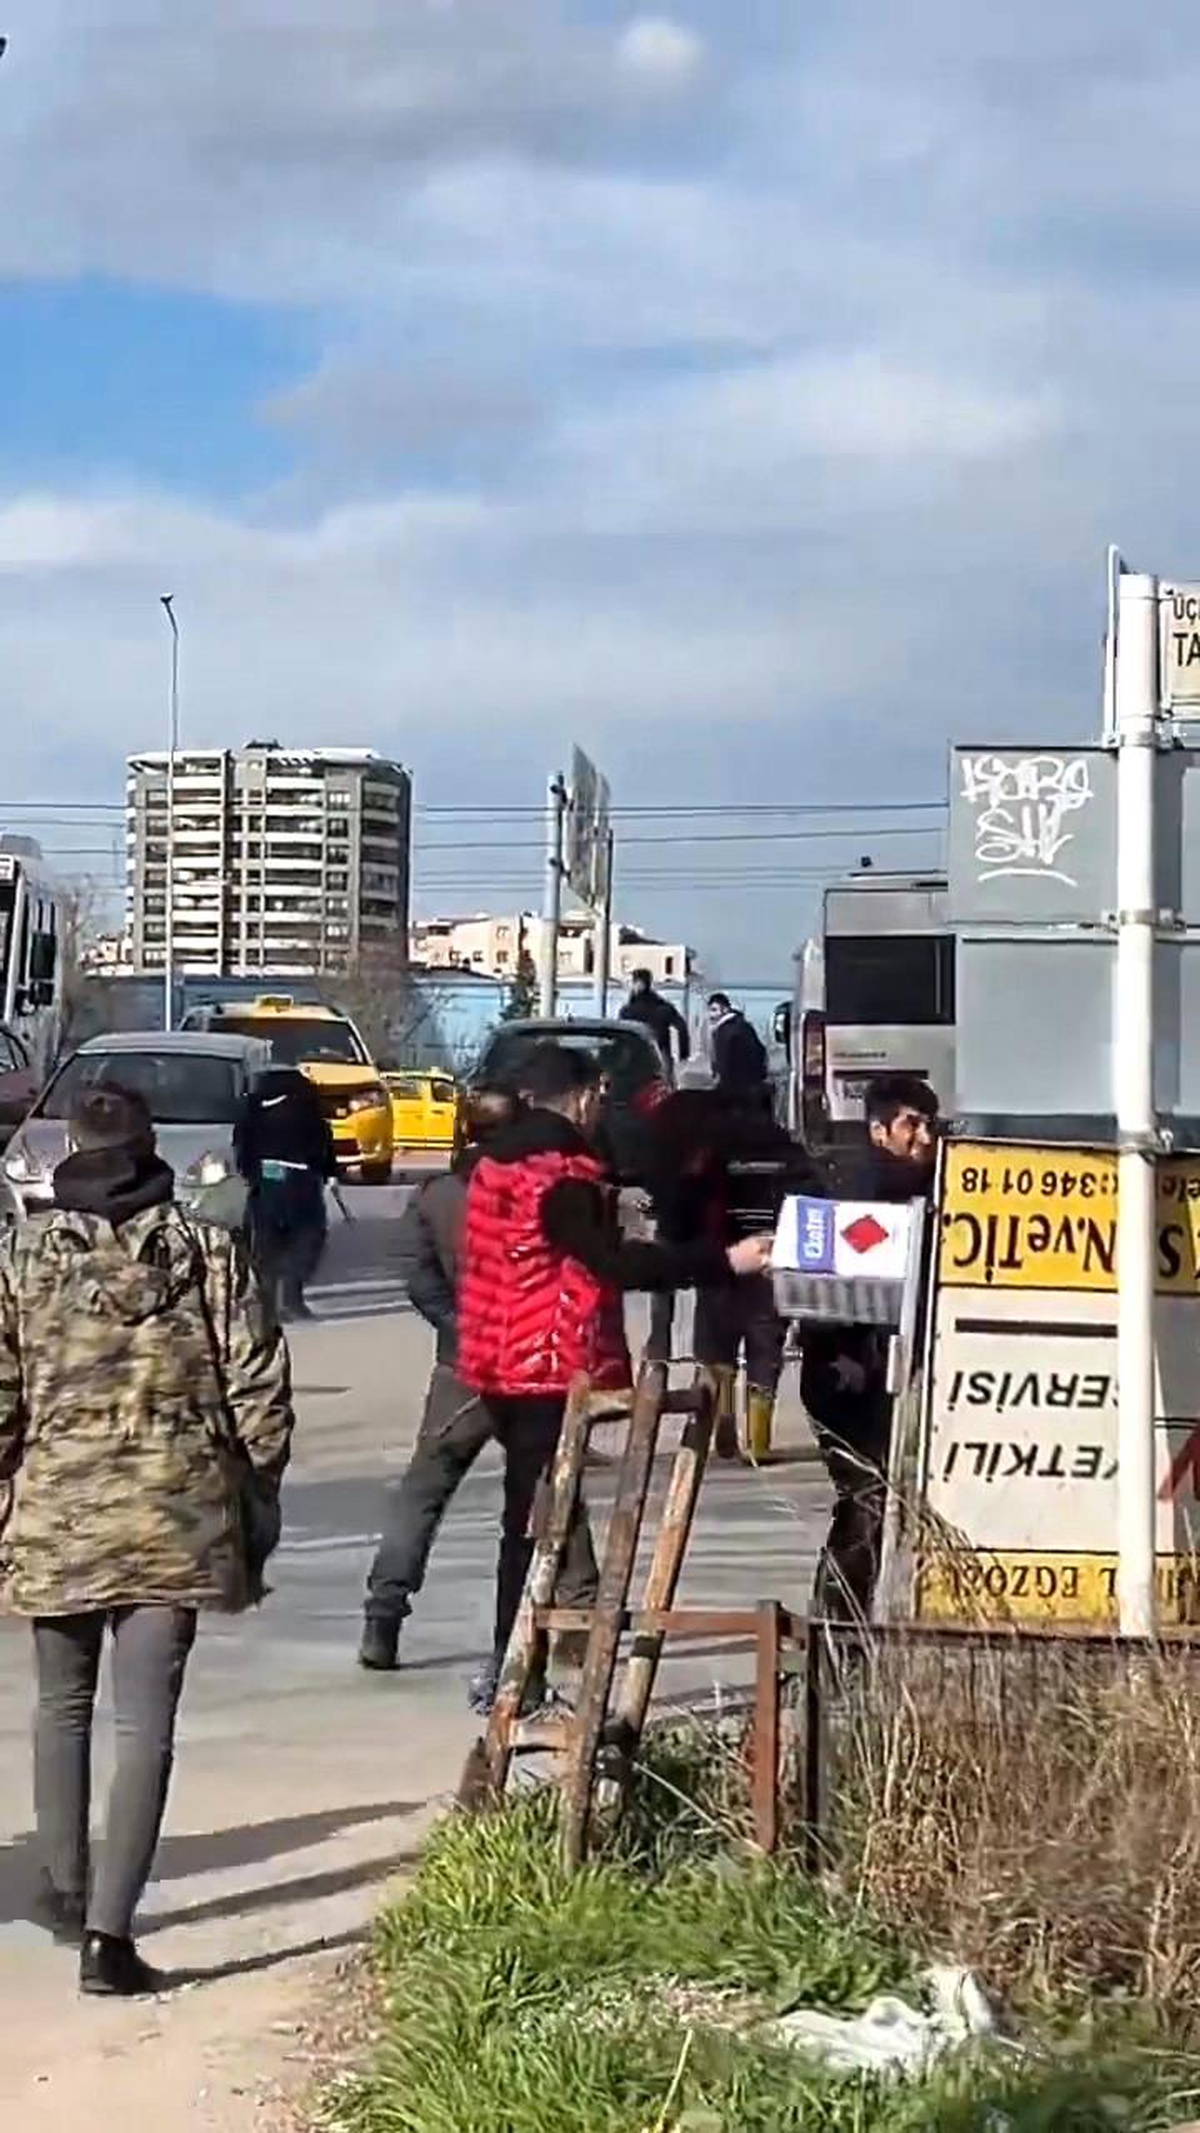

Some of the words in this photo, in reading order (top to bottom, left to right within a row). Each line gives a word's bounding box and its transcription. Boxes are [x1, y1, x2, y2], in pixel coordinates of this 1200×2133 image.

[1173, 592, 1200, 625] ÜÇ
[961, 1166, 989, 1192] 18
[947, 1370, 1119, 1413] ERVİSİ
